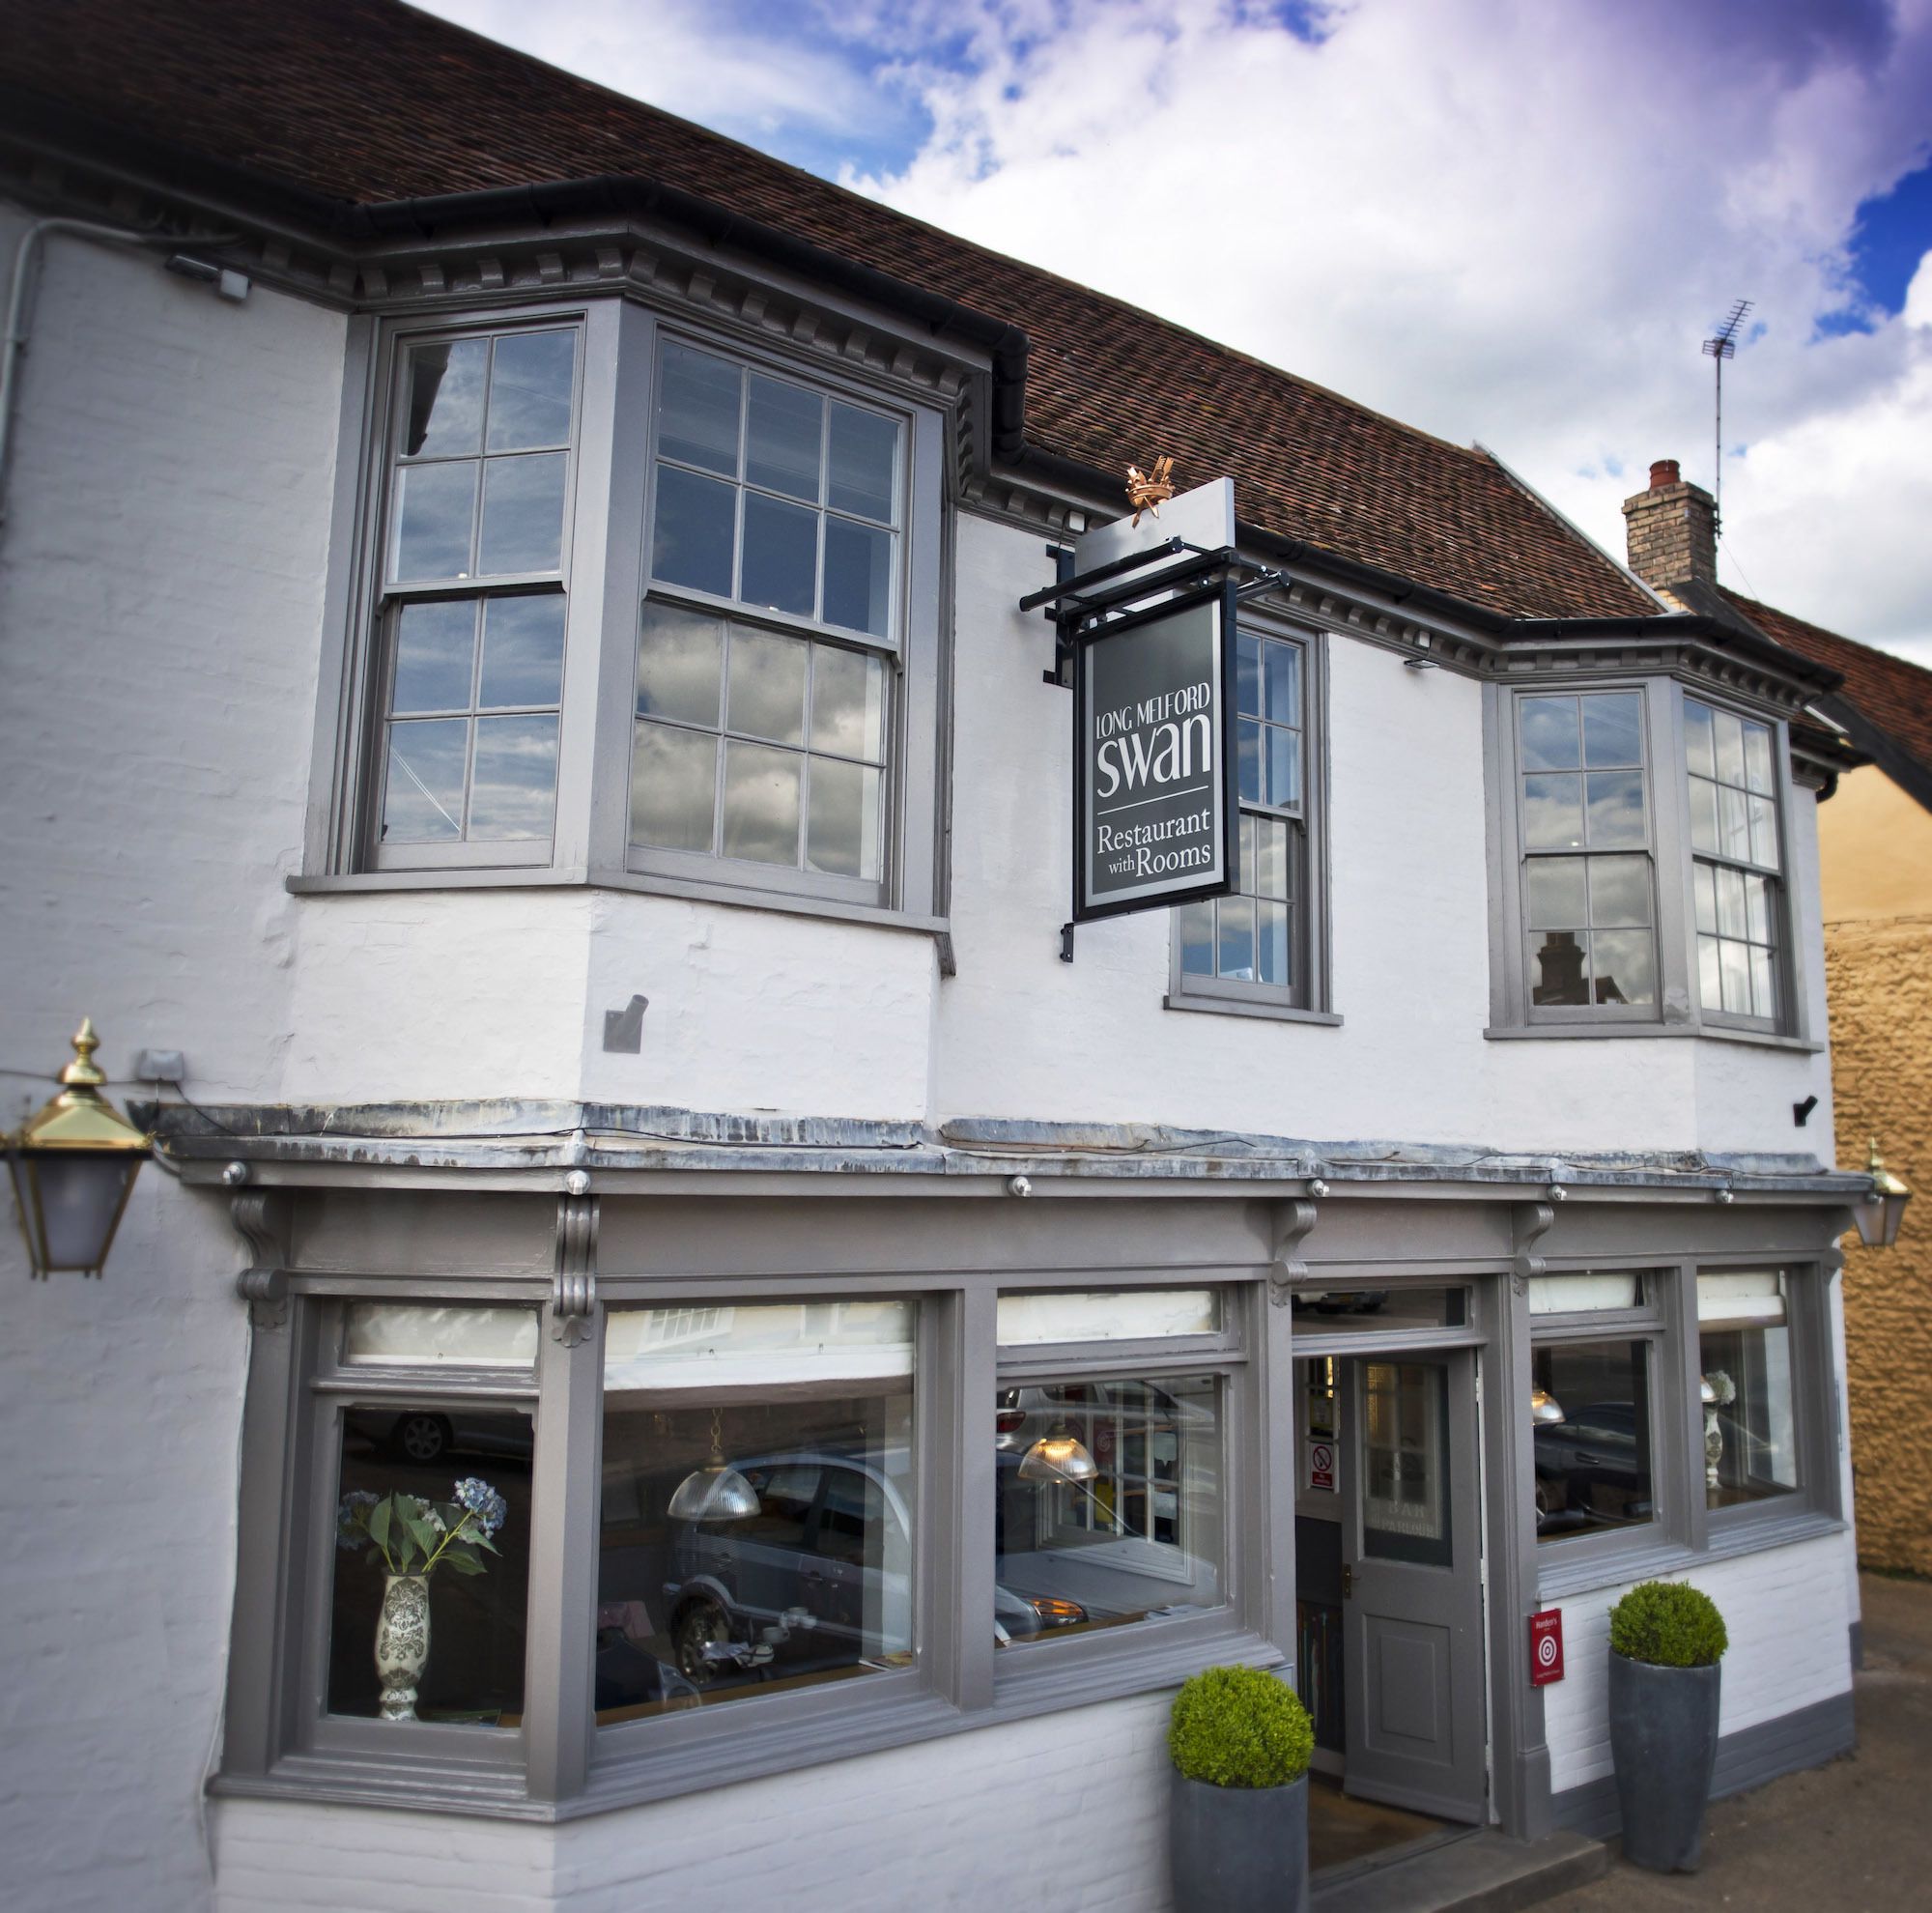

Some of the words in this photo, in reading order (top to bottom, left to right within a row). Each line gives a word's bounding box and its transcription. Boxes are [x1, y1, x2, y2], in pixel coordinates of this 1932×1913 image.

[1096, 705, 1132, 739] LONG
[1137, 682, 1210, 727] MELFORD
[1097, 714, 1210, 797] swan
[1097, 808, 1210, 854] Restaurant
[1109, 854, 1135, 873] with
[1136, 843, 1210, 877] Rooms
[1388, 1501, 1424, 1518] BAR
